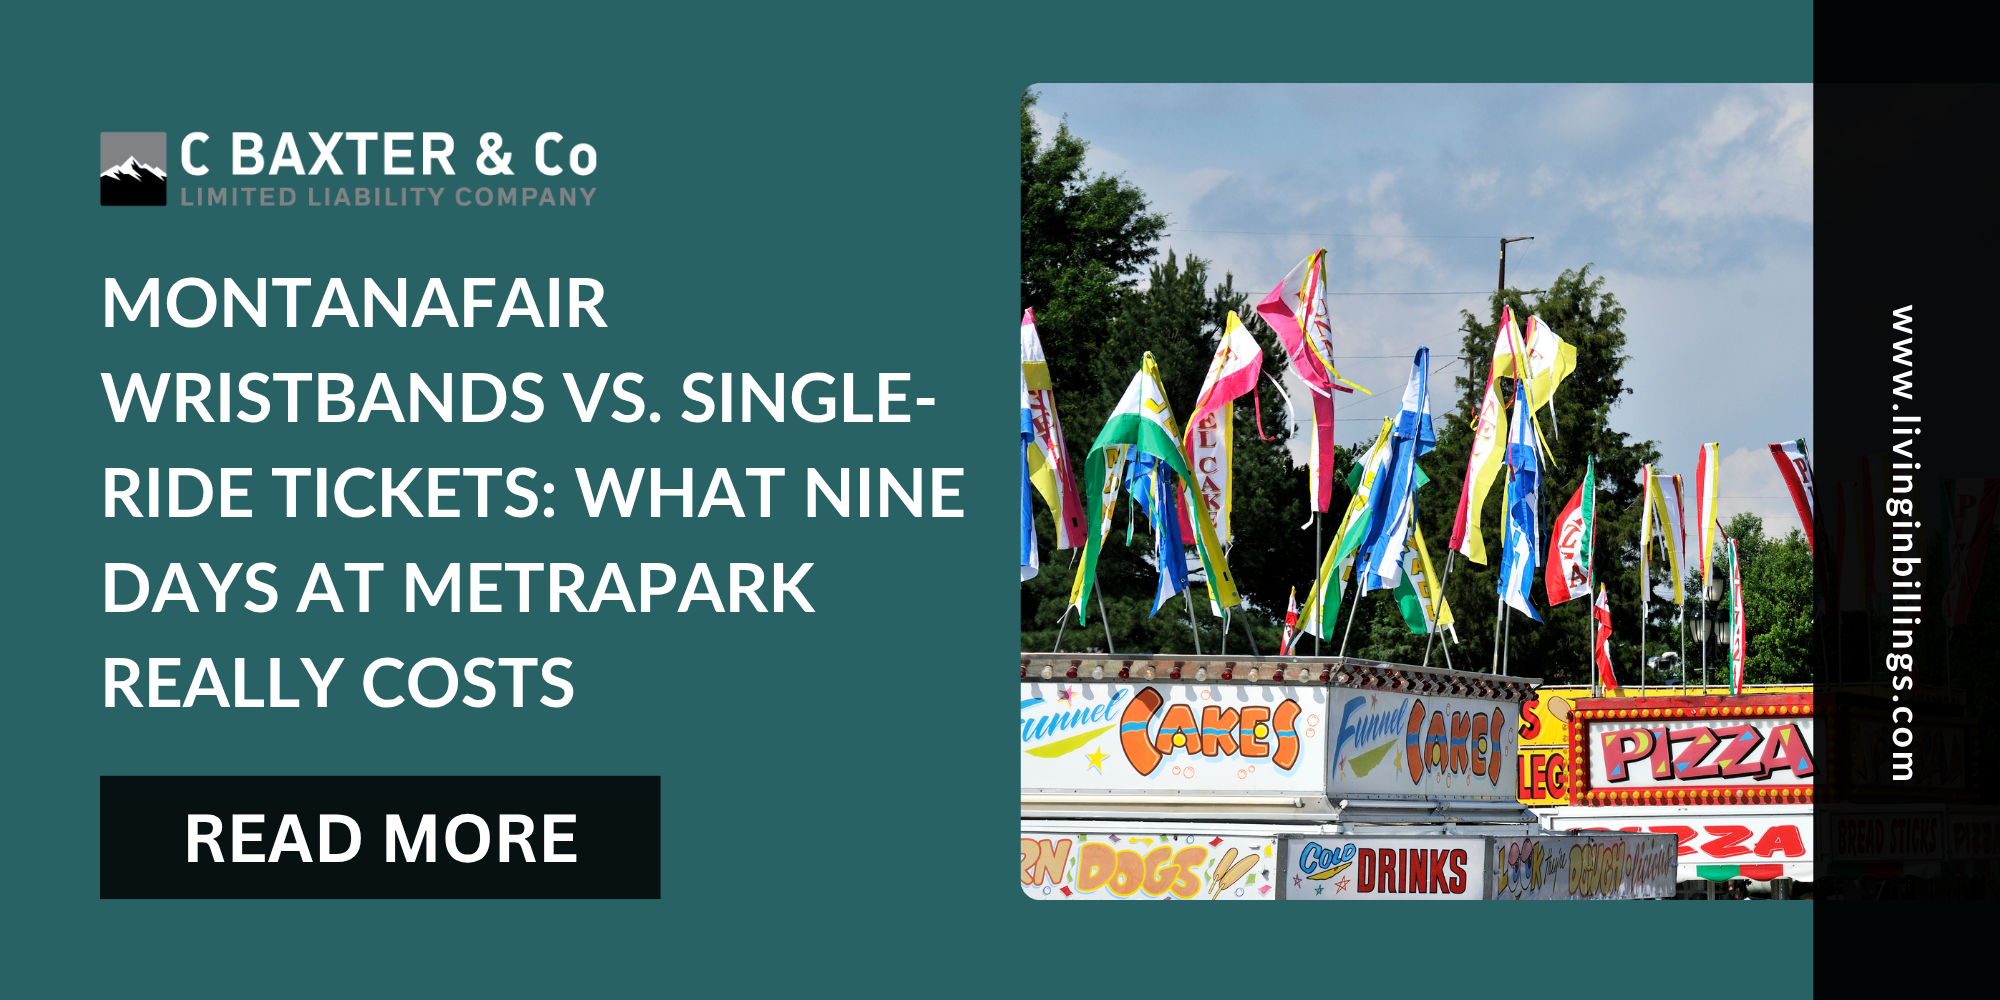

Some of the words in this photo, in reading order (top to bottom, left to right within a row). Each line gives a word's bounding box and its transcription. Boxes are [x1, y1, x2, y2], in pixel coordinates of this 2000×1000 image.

[1199, 456, 1222, 528] CAKE
[1119, 686, 1302, 777] CAKES
[1332, 695, 1409, 781] Funnel
[1406, 698, 1506, 786] CAKES
[1600, 723, 1818, 783] PIZZA
[1076, 842, 1209, 900] DOGS
[1299, 841, 1357, 874] COLD
[1357, 847, 1468, 895] DRINKS
